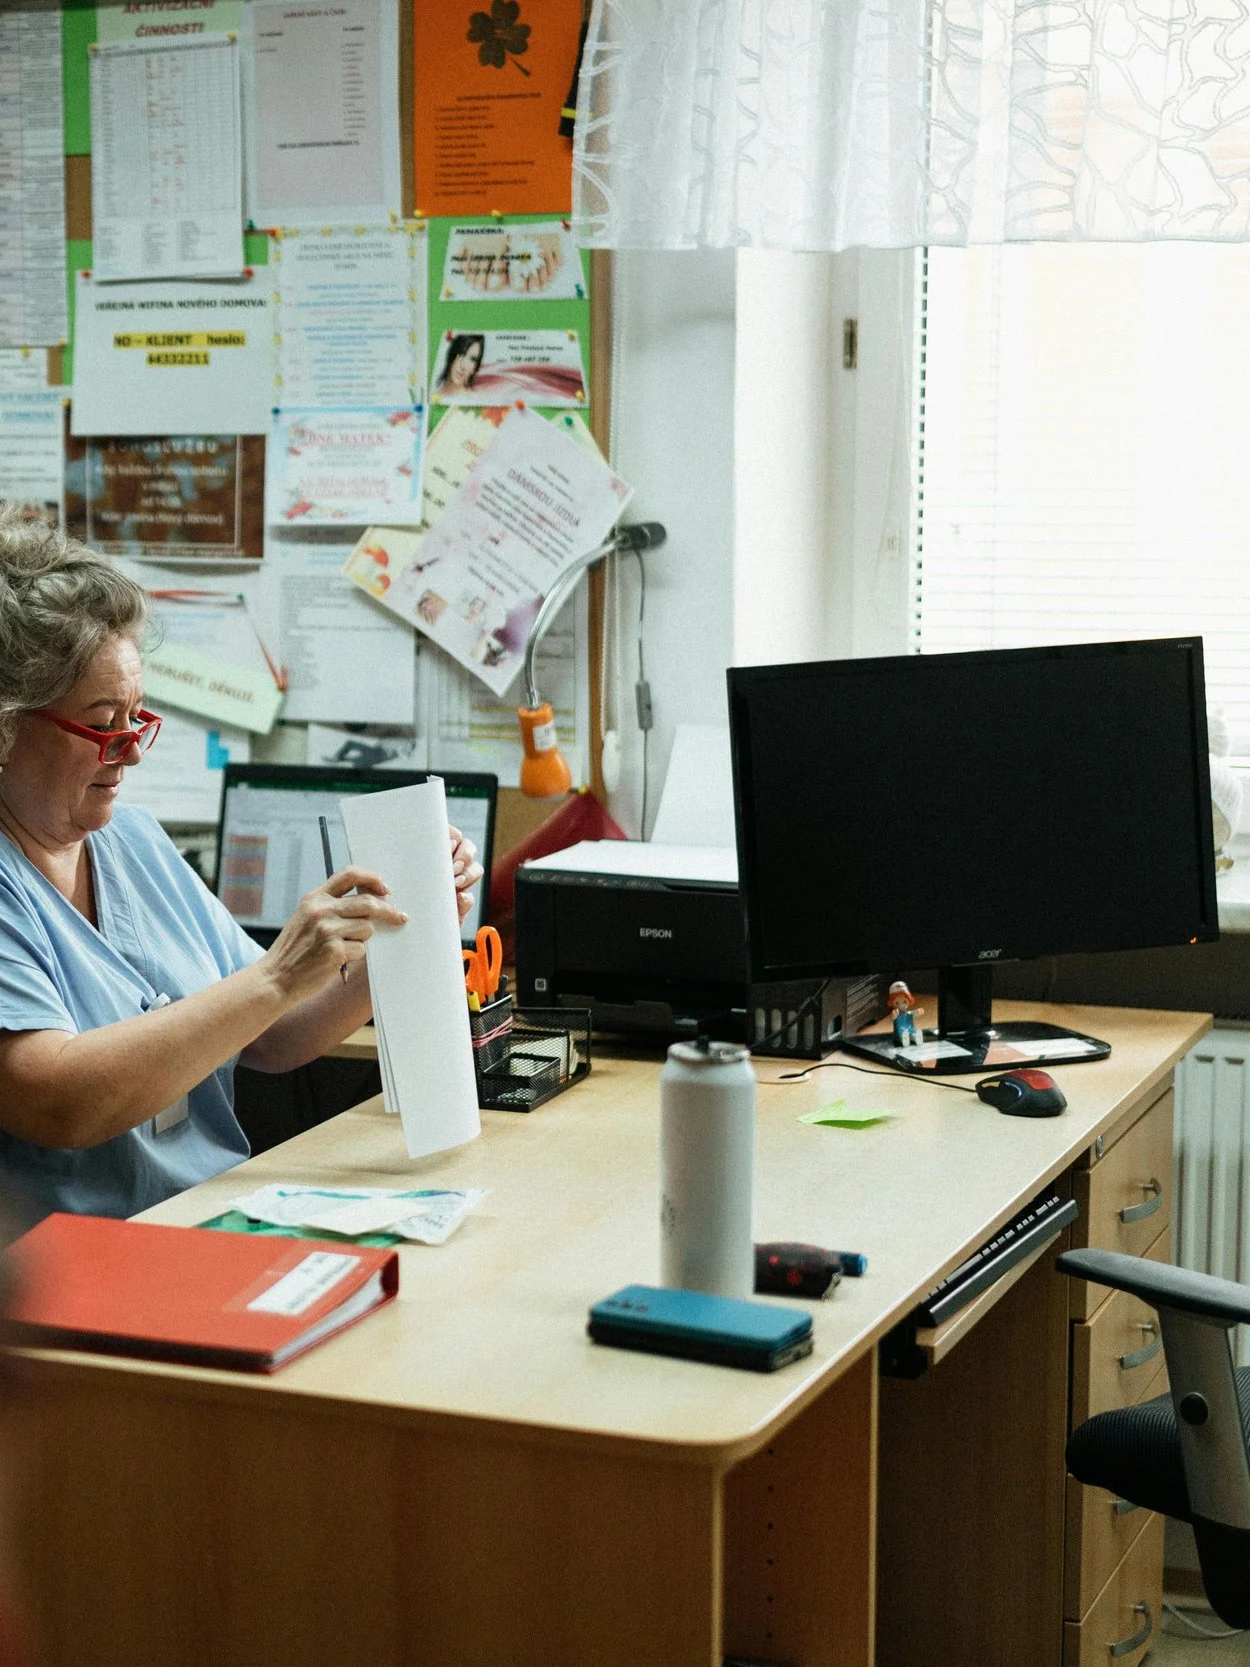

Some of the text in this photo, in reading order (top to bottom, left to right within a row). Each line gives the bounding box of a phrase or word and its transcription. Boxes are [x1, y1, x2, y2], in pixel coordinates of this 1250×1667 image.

[135, 22, 205, 37] ČINNOSTI
[177, 297, 218, 309] NOVÉHO
[220, 298, 267, 308] DOMOVA:
[146, 333, 193, 346] KLIENT
[207, 333, 245, 346] heslo:
[639, 927, 672, 938] EPSON
[978, 948, 1002, 959] acer
